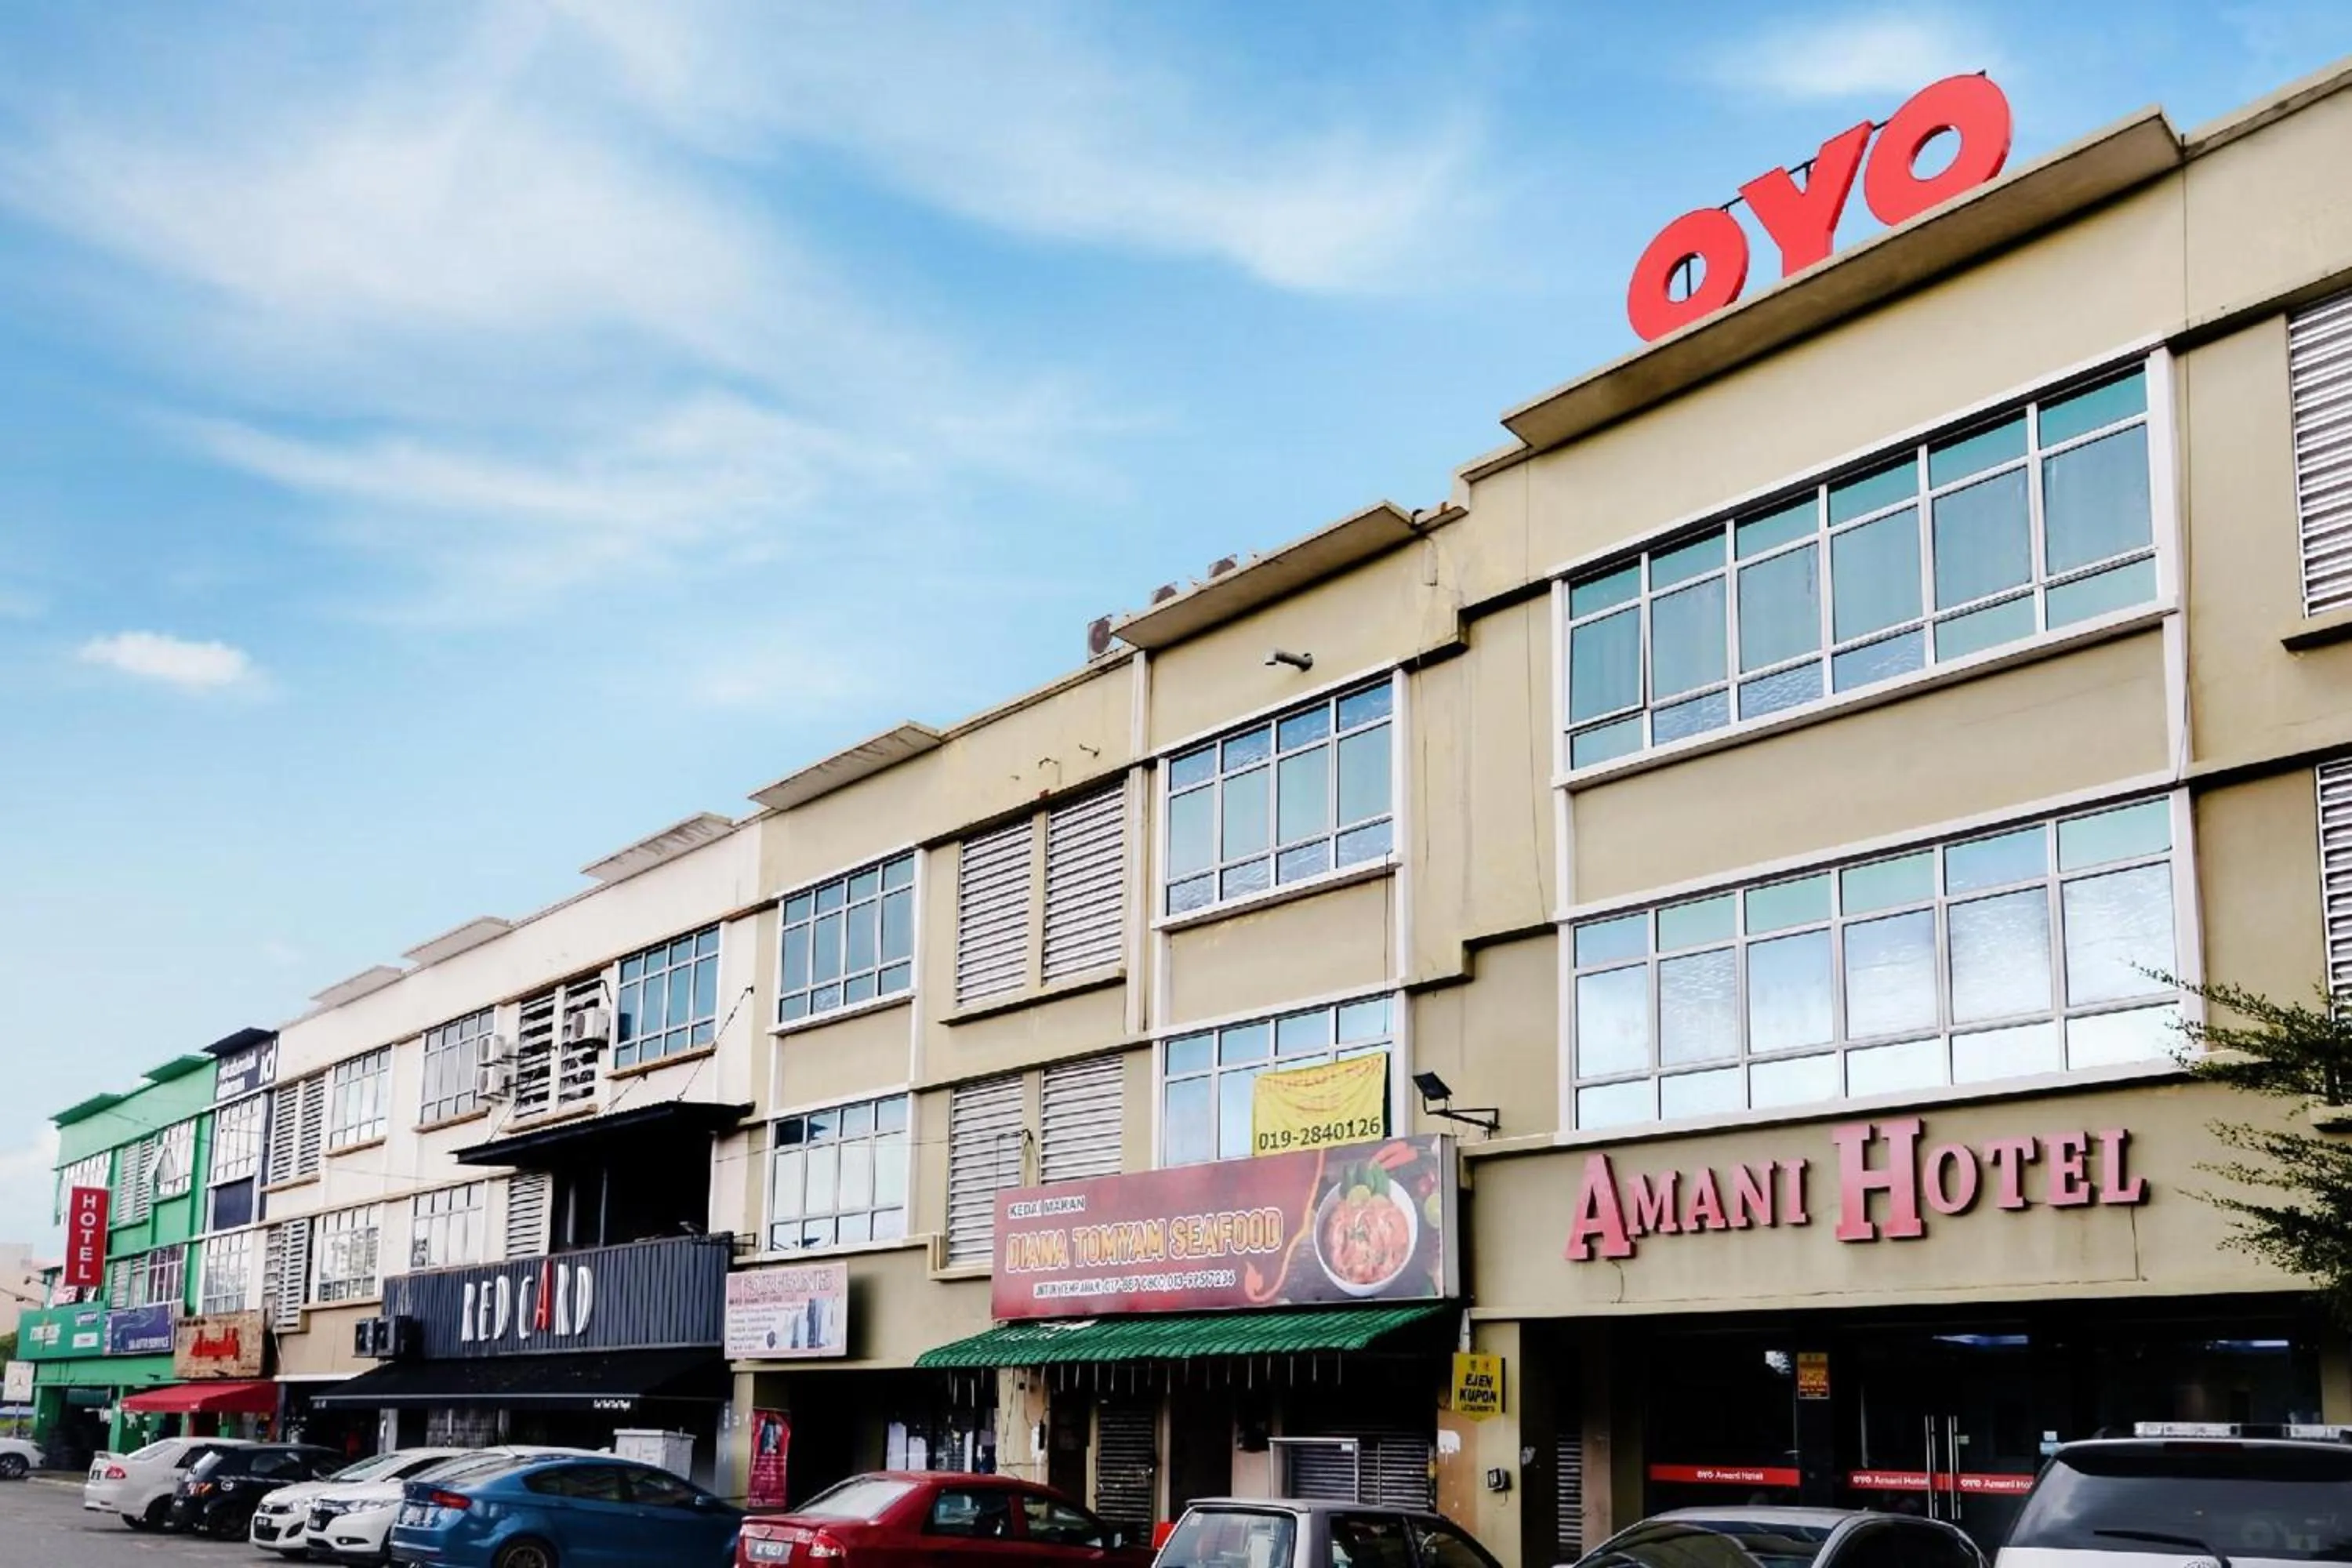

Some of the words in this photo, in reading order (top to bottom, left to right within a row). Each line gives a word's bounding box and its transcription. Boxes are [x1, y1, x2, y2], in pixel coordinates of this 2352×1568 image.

[1627, 74, 2013, 342] OYO
[1258, 1116, 1381, 1150] 019-2840126
[1044, 1195, 1086, 1213] MAKAN
[1565, 1153, 1810, 1261] AMANI
[1832, 1117, 2150, 1243] HOTEL
[78, 1192, 97, 1279] HOTEL
[1007, 1229, 1069, 1272] DIANA
[1073, 1218, 1167, 1268] TOMYAM
[1170, 1207, 1283, 1260] SEAFOOD
[462, 1275, 510, 1341] RED
[518, 1259, 593, 1340] CARD
[1458, 1388, 1497, 1403] KUPON
[1465, 1373, 1494, 1388] EJEN
